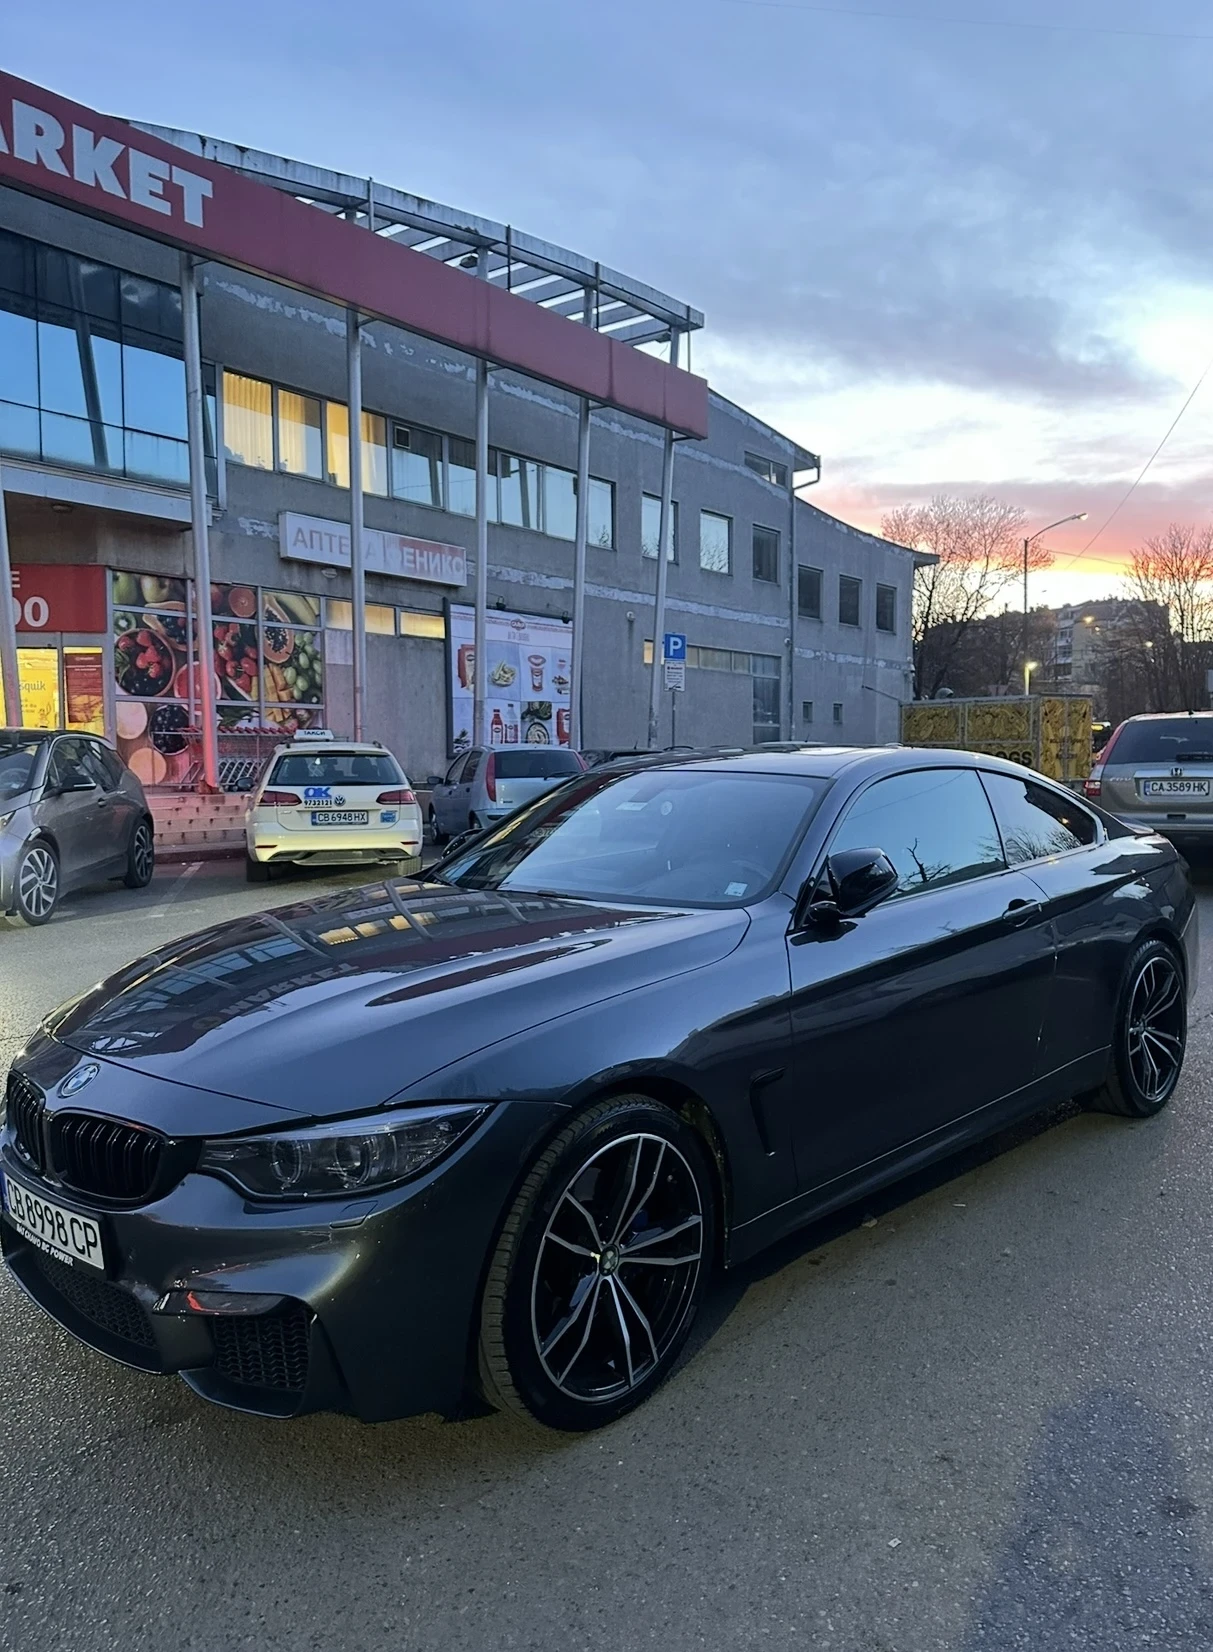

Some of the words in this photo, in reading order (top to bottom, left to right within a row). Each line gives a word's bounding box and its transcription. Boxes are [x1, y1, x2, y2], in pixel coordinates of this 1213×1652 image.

[0, 99, 213, 228] RKET
[292, 527, 376, 560] АПТЕА
[670, 637, 682, 656] P
[304, 787, 331, 798] OK
[1151, 782, 1165, 792] CA
[1166, 782, 1191, 792] 3589
[1193, 782, 1206, 792] HK
[318, 813, 330, 822] CB
[331, 813, 352, 822] 6948
[354, 813, 366, 821] HX
[7, 1179, 25, 1220] CB
[25, 1194, 68, 1246] 8998
[70, 1217, 98, 1258] CP
[50, 1247, 73, 1266] POWER
